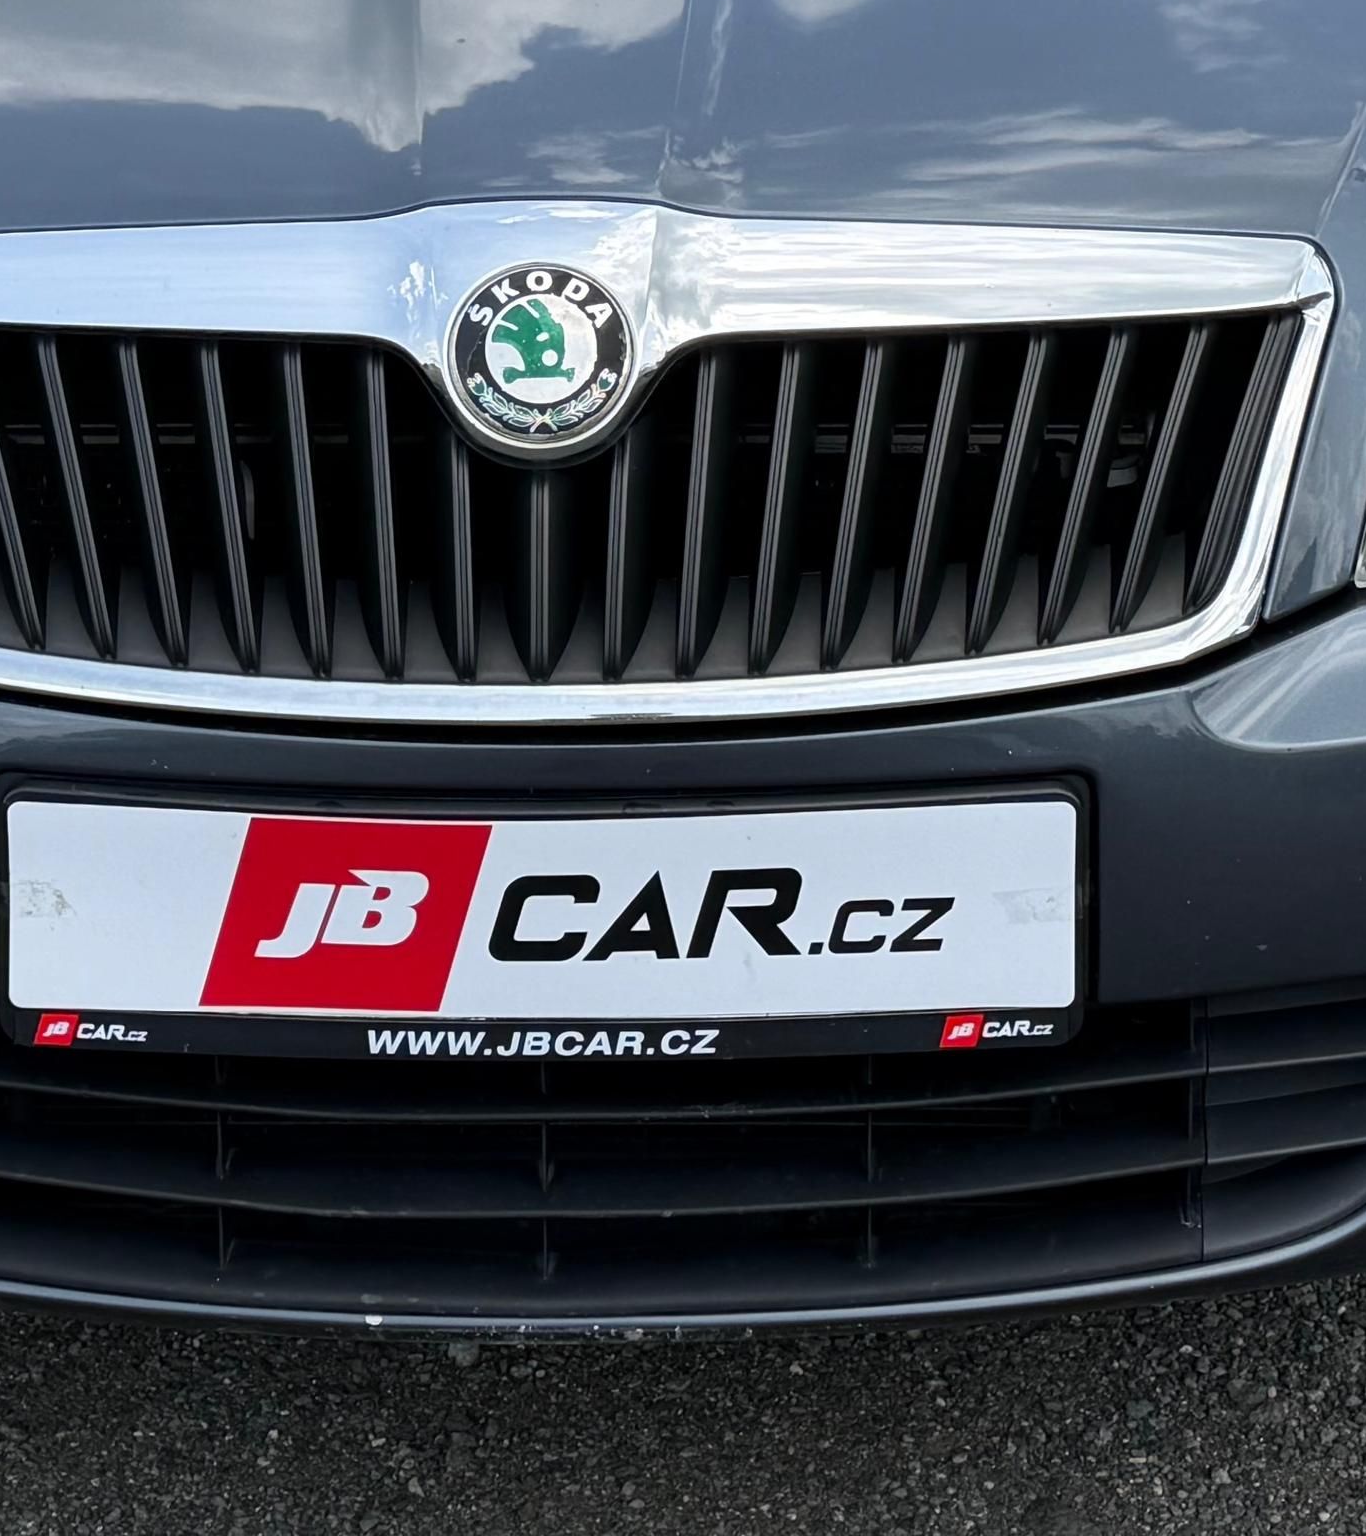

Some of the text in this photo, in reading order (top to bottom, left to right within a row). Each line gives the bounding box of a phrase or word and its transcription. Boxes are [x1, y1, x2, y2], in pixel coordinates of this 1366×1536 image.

[254, 869, 430, 958] JB
[42, 1021, 69, 1037] JB
[947, 1022, 974, 1040] JB
[367, 1029, 720, 1056] WWW.JBCAR.CZ
